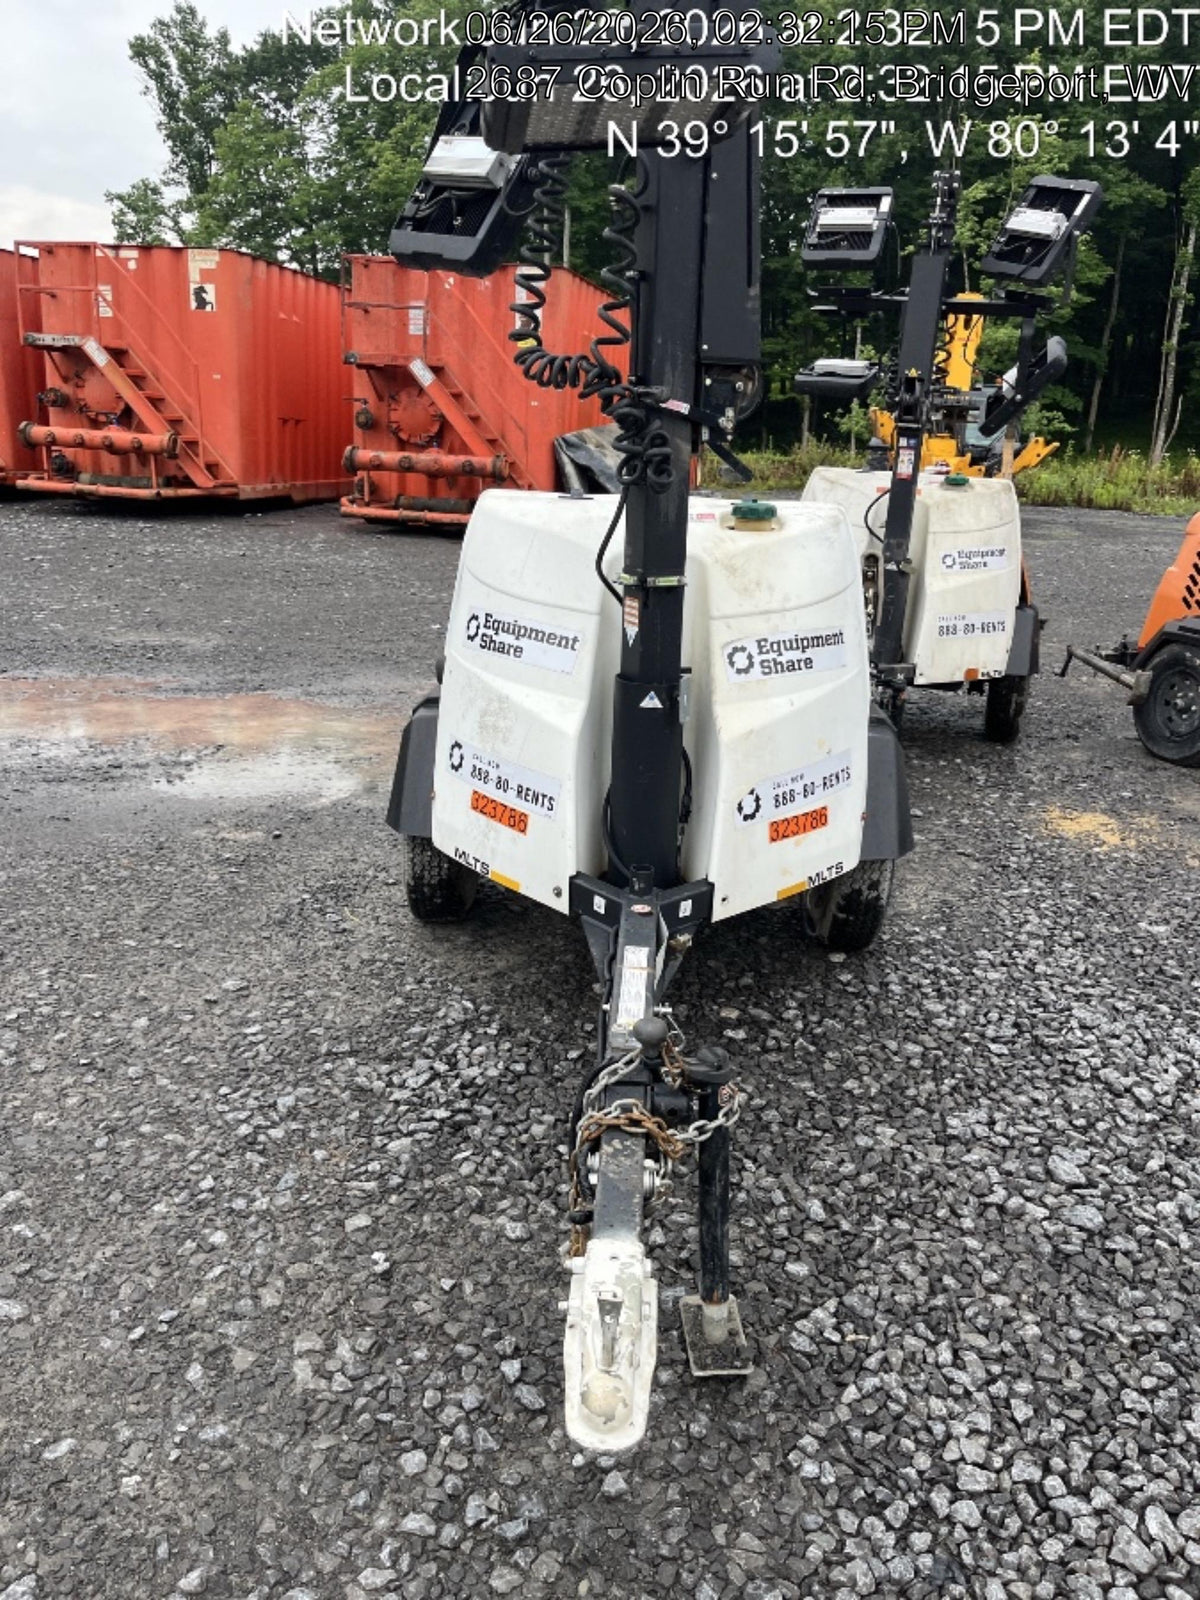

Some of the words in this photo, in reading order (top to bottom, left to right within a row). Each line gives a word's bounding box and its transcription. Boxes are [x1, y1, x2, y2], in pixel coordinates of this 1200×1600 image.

[479, 631, 524, 658] Share
[483, 613, 580, 651] Equipment
[755, 630, 845, 656] Equipment
[759, 655, 814, 676] Share
[773, 766, 851, 810] 888-80-RENTS
[471, 789, 528, 834] 323786
[769, 806, 829, 843] 323786
[453, 847, 490, 876] MLTS
[807, 862, 844, 887] MLTS
